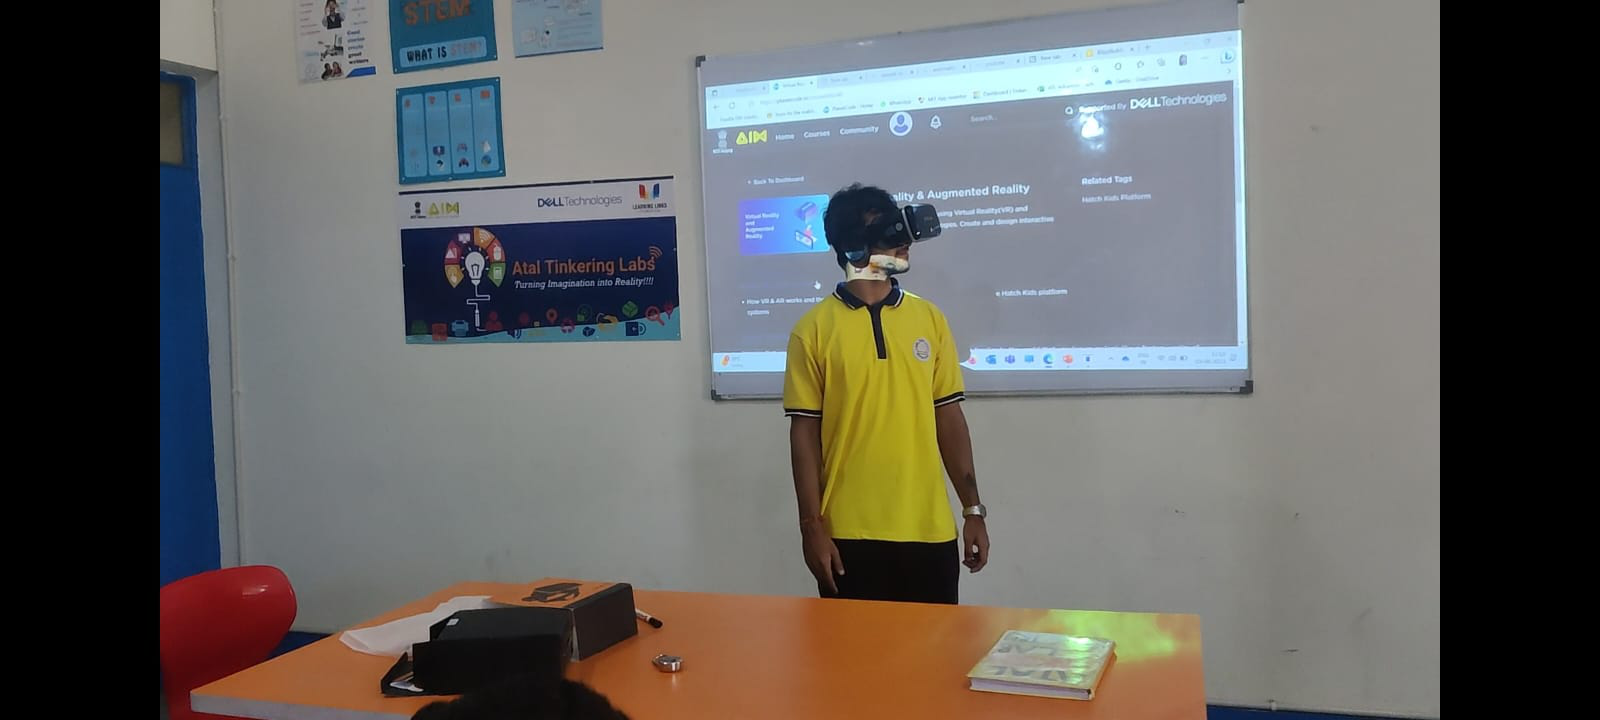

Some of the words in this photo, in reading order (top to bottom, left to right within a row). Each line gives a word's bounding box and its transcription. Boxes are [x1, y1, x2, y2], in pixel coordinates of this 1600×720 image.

[403, 0, 471, 26] STEM
[407, 48, 433, 65] WHAT
[437, 46, 448, 59] IS
[803, 130, 830, 138] Courses
[840, 126, 879, 136] Community
[1081, 176, 1113, 185] Related
[1114, 175, 1133, 184] Tags
[893, 190, 915, 203] ality
[916, 190, 925, 201] &
[927, 186, 989, 201] Augmented
[992, 183, 1030, 196] Reality
[512, 260, 541, 275] Atal
[545, 258, 614, 276] Tinkering
[619, 256, 656, 272] Labs
[514, 280, 546, 290] Turning
[547, 278, 595, 289] Imagination
[597, 278, 613, 287] into
